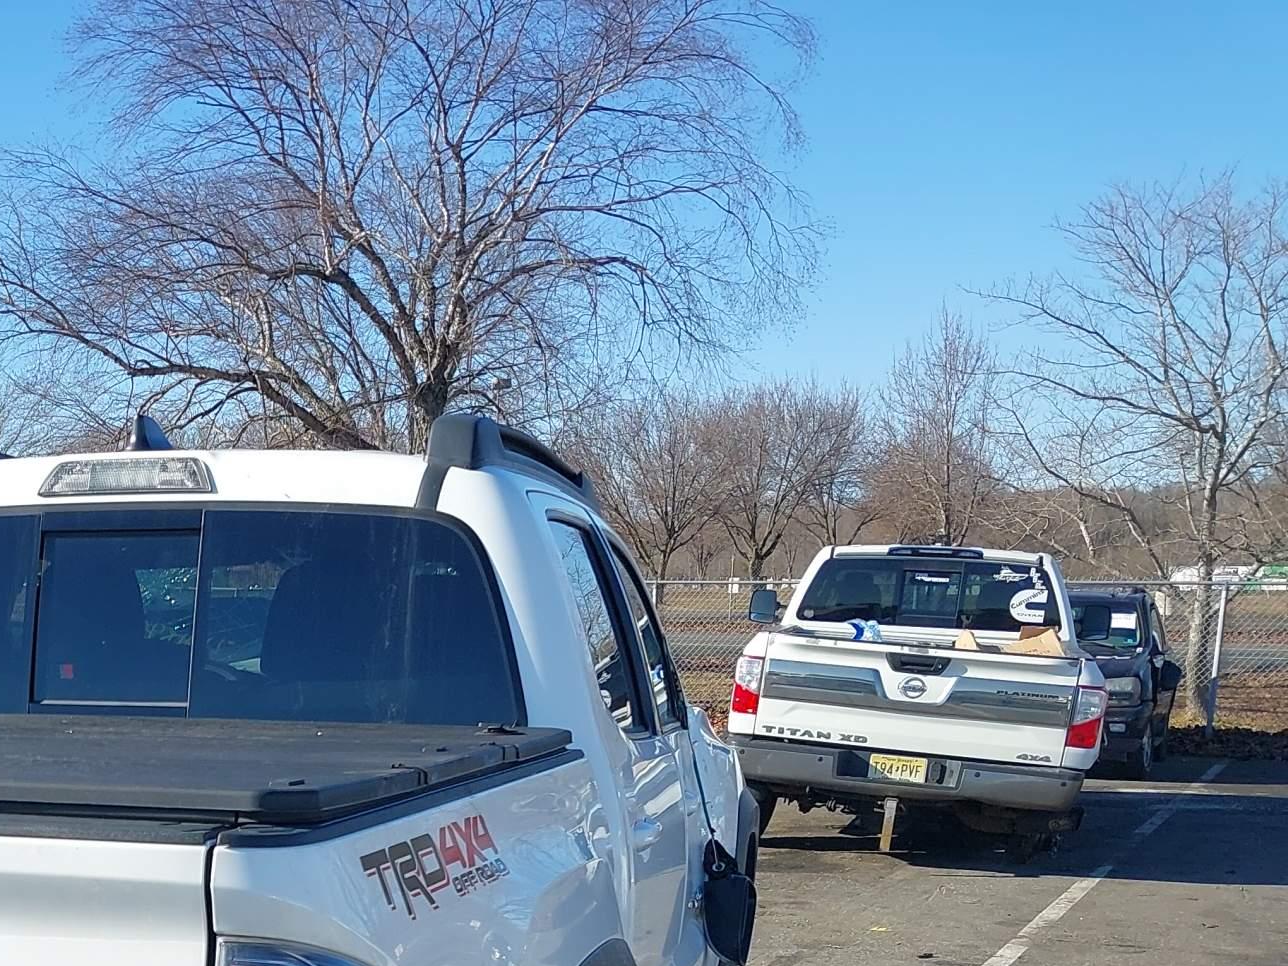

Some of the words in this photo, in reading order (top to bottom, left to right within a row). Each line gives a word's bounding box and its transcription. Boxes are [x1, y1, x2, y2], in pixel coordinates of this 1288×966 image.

[1011, 590, 1045, 609] Cummins
[996, 690, 1059, 699] PLATINUM
[762, 725, 831, 740] TITAN
[839, 733, 868, 744] XD
